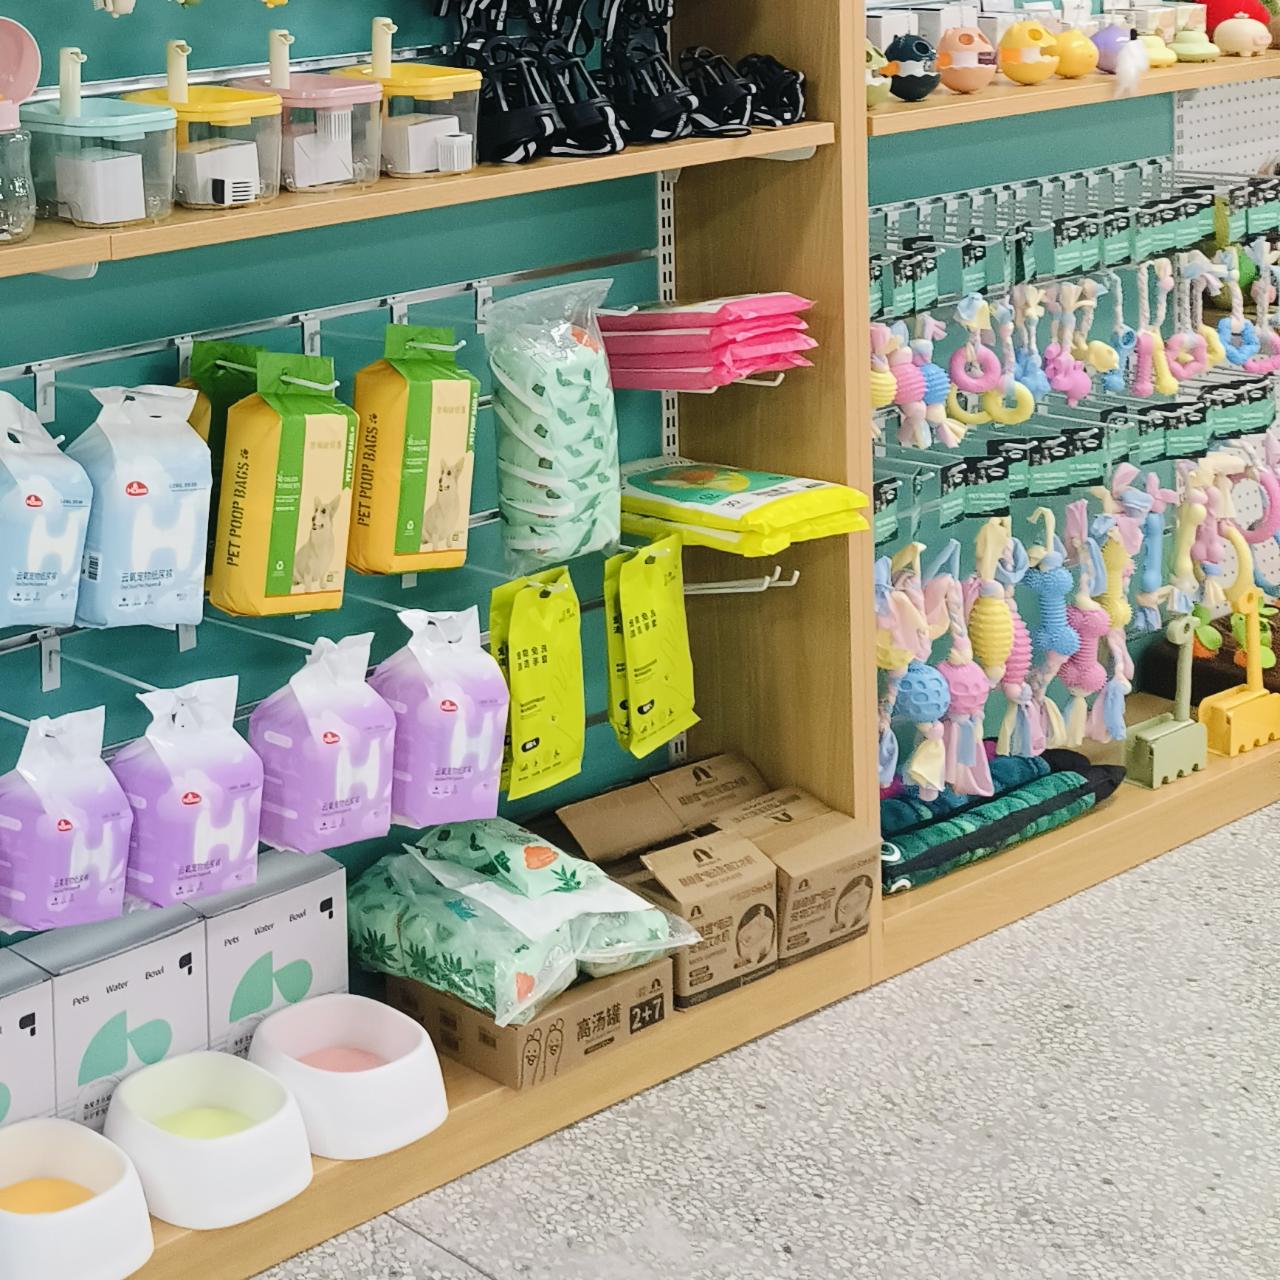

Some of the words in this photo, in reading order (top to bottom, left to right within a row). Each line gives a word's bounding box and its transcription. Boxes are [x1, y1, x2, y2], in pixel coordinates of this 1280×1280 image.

[363, 426, 378, 461] BAGS
[234, 462, 250, 499] BAGS
[360, 464, 375, 499] POOP
[230, 501, 245, 536] POOP
[357, 500, 371, 527] PET
[227, 537, 241, 567] PET
[223, 935, 240, 948] Pets
[253, 921, 276, 937] Water
[288, 908, 307, 923] Bowl
[72, 993, 90, 1007] Pets
[105, 979, 129, 995] Water
[145, 966, 165, 980] Bowl
[631, 997, 662, 1030] 2+7
